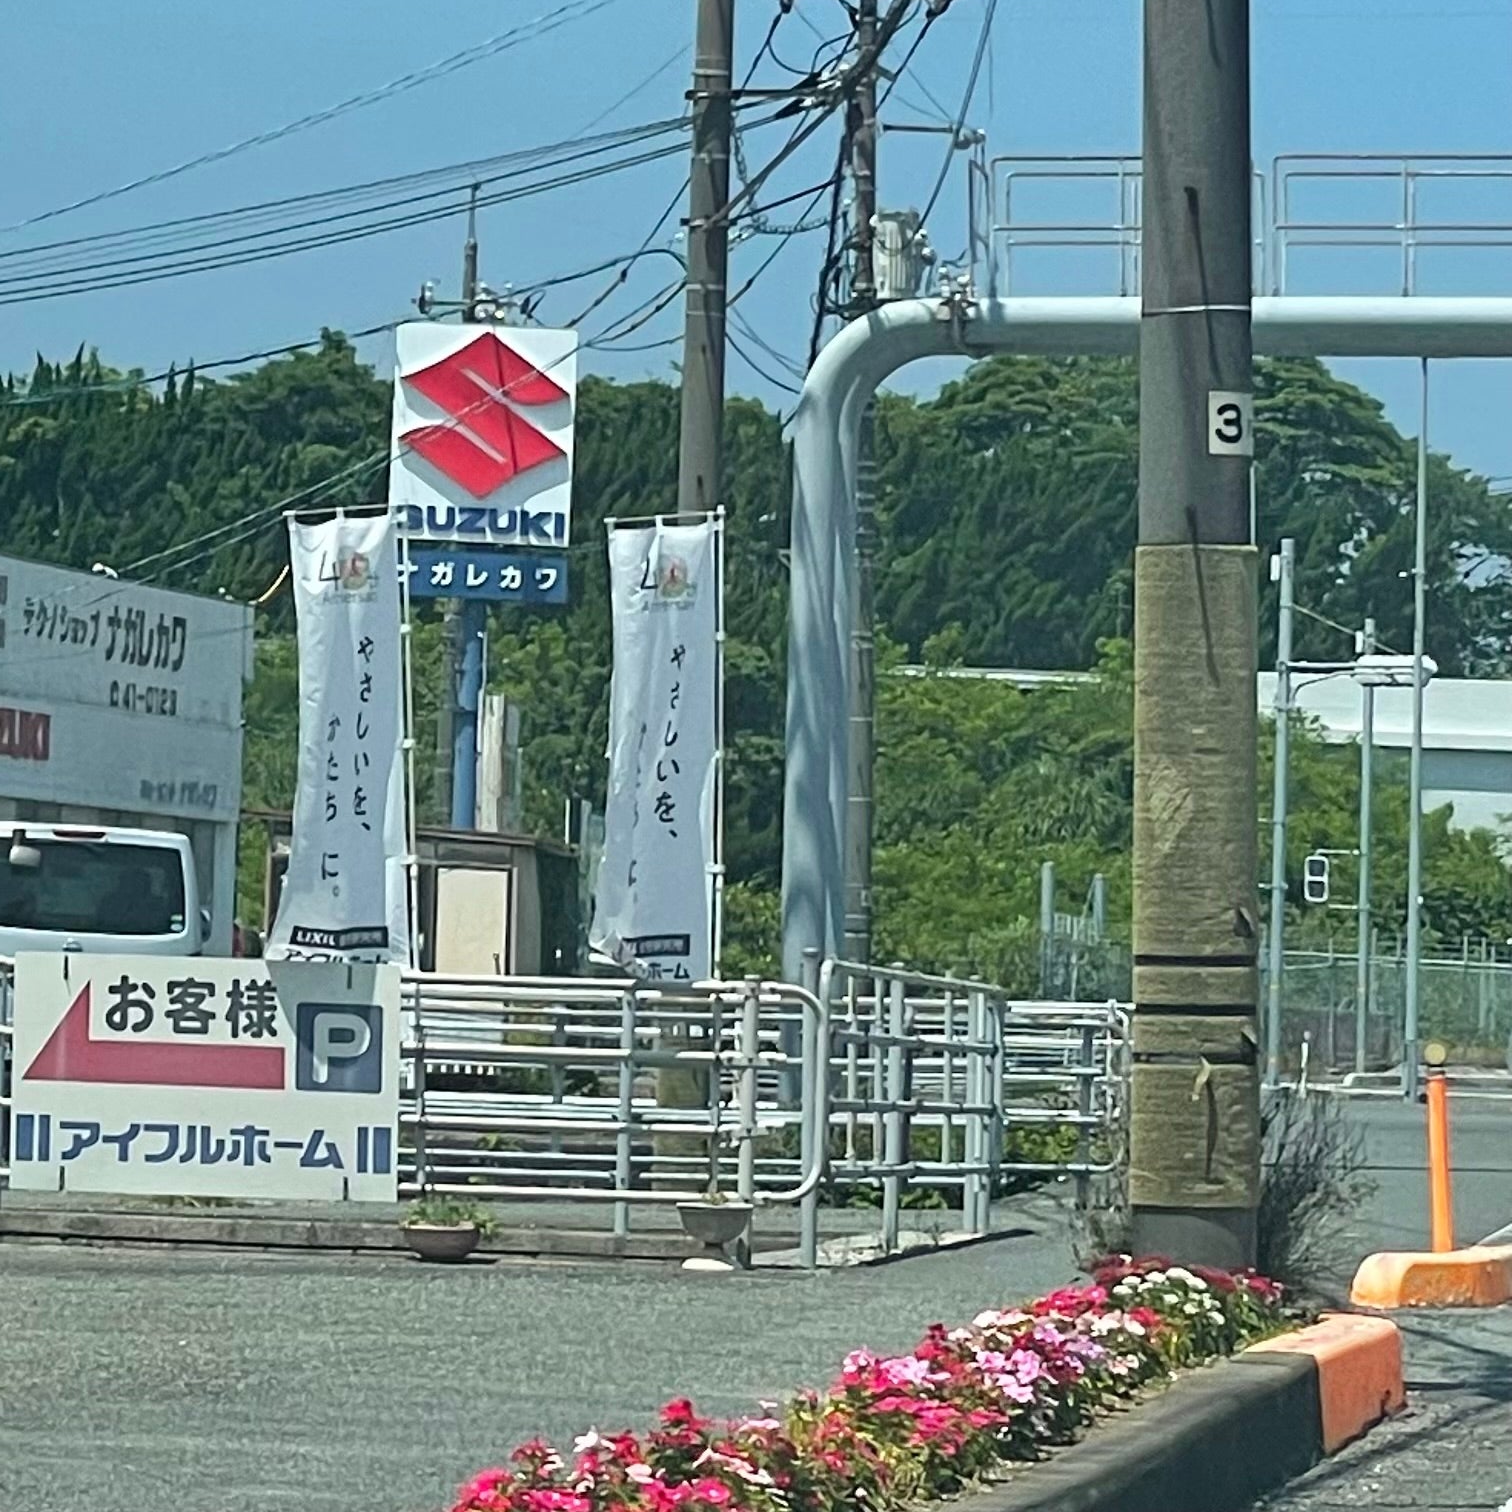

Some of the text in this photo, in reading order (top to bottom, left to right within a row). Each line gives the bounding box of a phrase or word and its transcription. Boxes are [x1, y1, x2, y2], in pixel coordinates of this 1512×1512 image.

[1215, 403, 1243, 443] 3
[105, 605, 187, 672] ナガレカワ
[296, 931, 336, 945] LIXIL
[105, 975, 372, 1084] お客様 P
[59, 1120, 345, 1169] アイフルホーム
